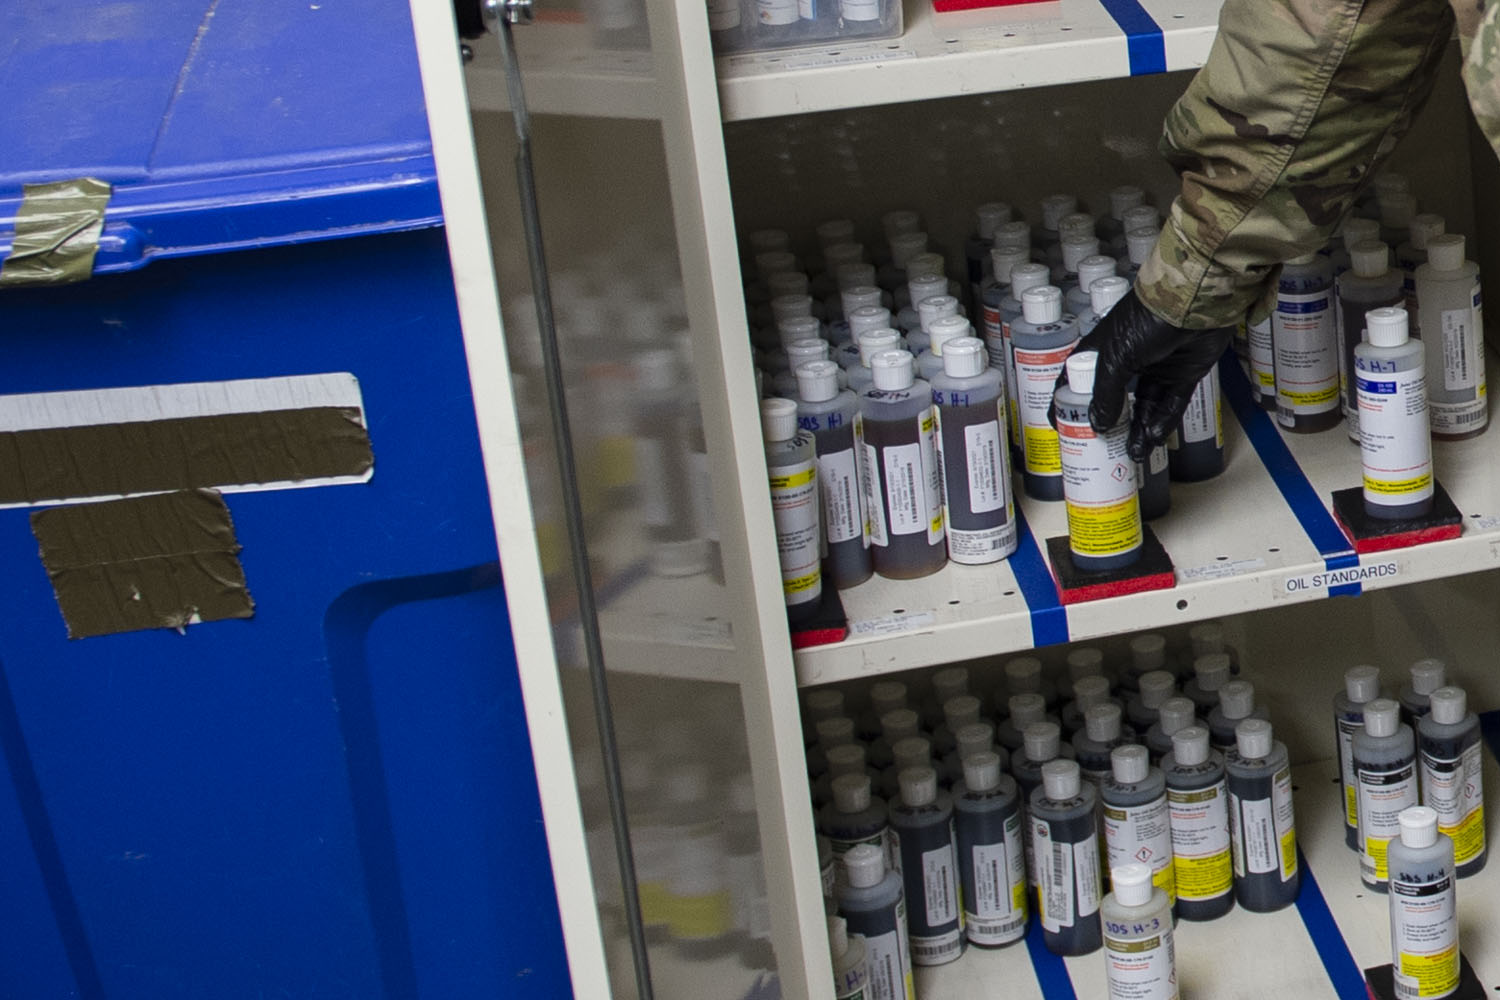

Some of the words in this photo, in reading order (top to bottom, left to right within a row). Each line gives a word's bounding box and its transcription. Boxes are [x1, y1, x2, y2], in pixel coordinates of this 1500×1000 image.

[1370, 360, 1396, 373] H-7
[951, 394, 969, 408] H-1
[828, 412, 843, 429] H-1
[1070, 410, 1087, 422] H-
[1286, 578, 1309, 591] OIL
[1312, 563, 1397, 587] STANDARDS
[1427, 868, 1445, 882] H-4
[1105, 921, 1128, 935] SDS
[1133, 918, 1160, 934] H-3
